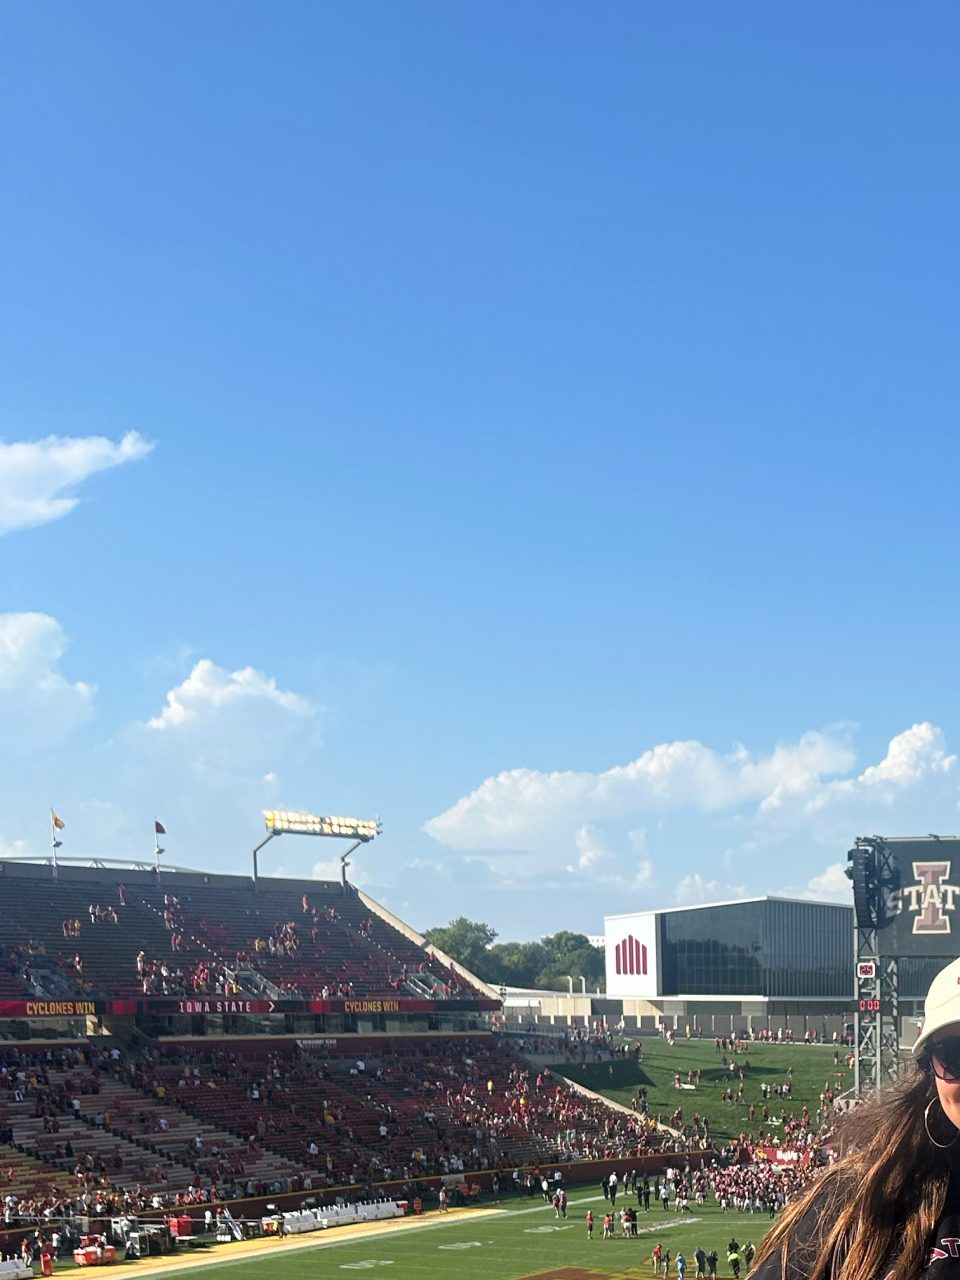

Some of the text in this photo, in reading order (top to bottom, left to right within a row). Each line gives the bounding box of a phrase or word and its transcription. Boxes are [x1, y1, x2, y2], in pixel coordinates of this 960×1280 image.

[26, 1001, 95, 1015] CYCLONES WIN
[180, 1001, 250, 1013] IOWA STATE
[344, 1001, 399, 1012] CYCLONES WIN
